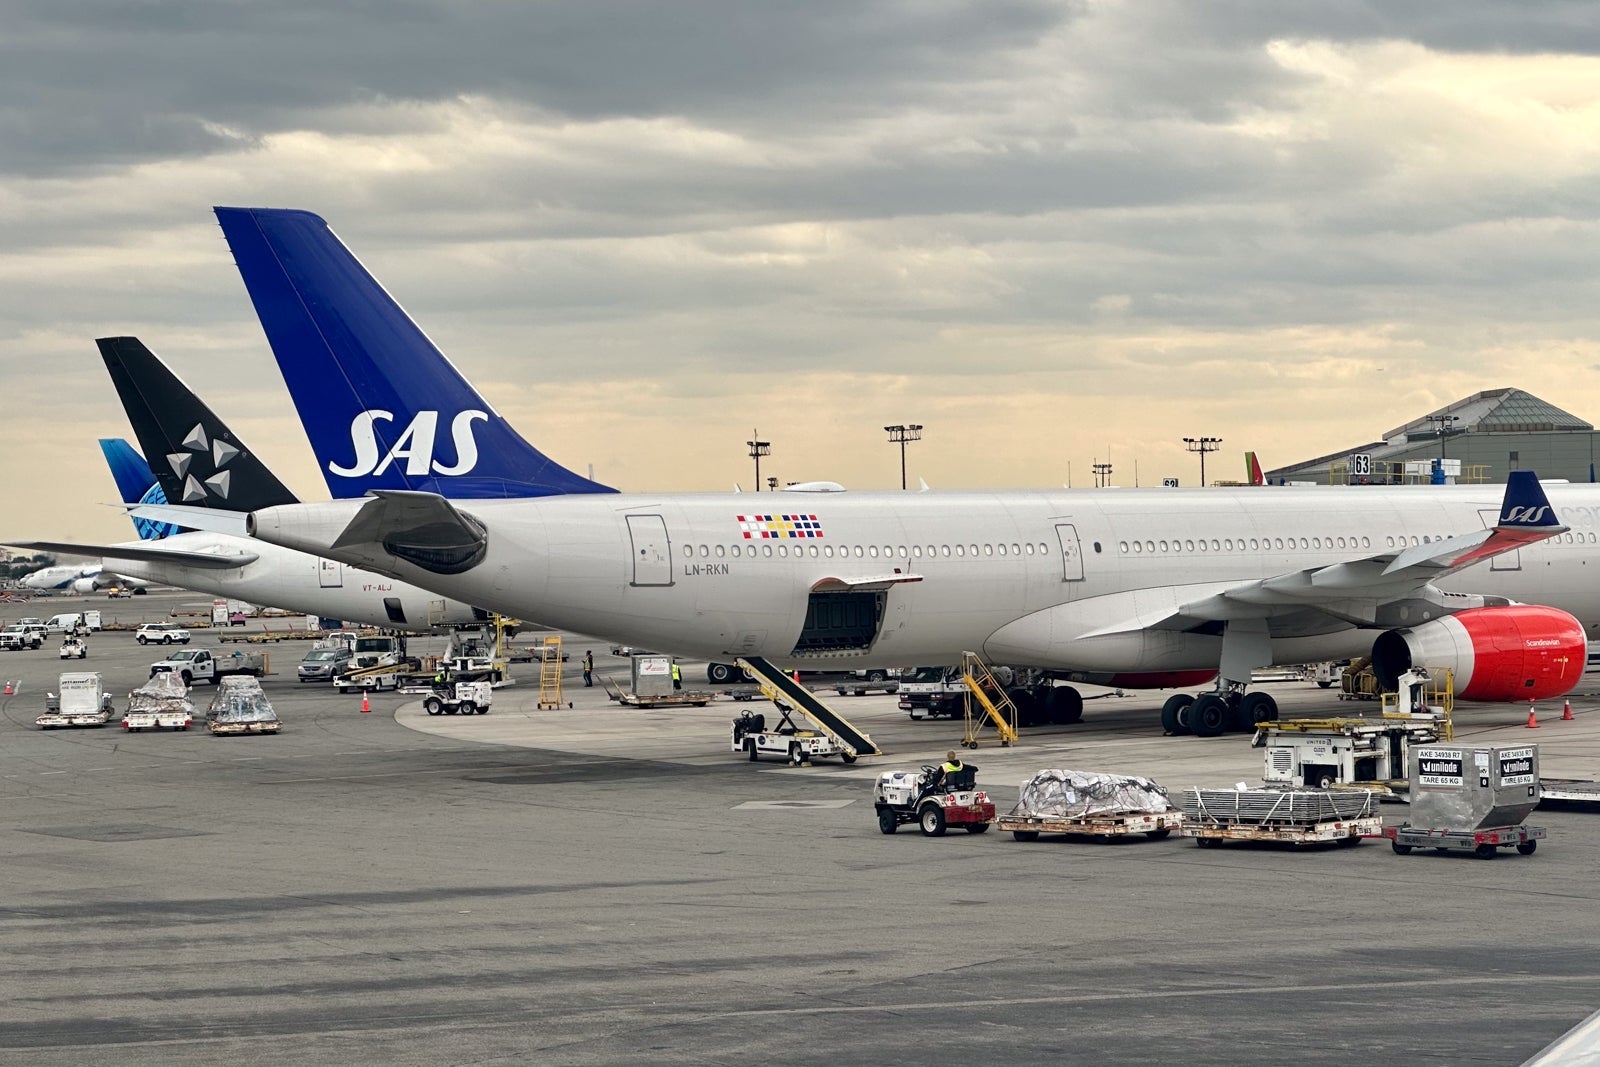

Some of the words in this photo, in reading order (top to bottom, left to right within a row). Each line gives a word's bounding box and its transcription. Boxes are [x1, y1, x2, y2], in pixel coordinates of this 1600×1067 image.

[328, 409, 489, 478] SAS
[1355, 455, 1369, 474] 63
[1501, 505, 1550, 523] SAS
[685, 564, 729, 576] LN-RKN
[1431, 761, 1458, 772] unilode
[1509, 760, 1530, 772] unilode
